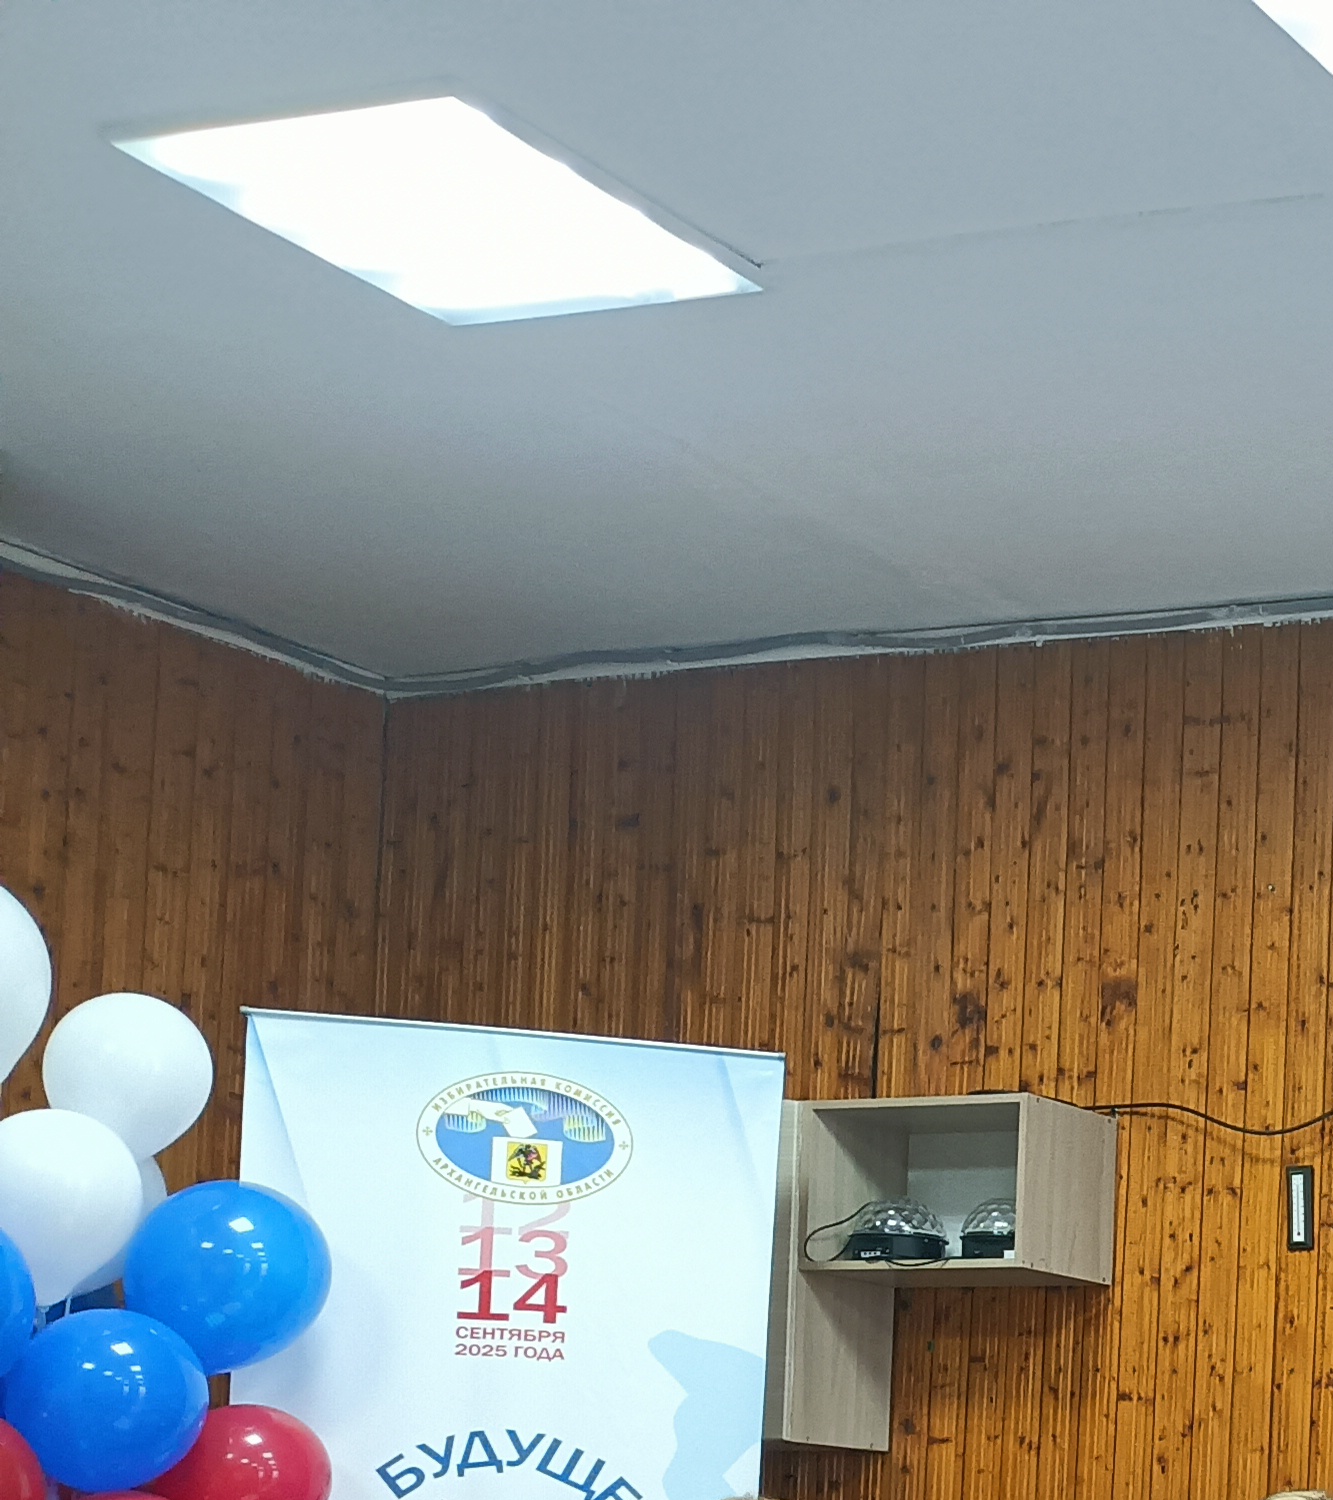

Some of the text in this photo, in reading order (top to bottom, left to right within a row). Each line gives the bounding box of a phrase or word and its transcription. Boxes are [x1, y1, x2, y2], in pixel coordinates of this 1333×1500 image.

[554, 1081, 622, 1127] КОМИССИЯ
[556, 1168, 615, 1199] ОБЛАСТИ
[458, 1226, 569, 1280] 13
[457, 1270, 568, 1324] 14
[454, 1344, 565, 1362] 2025 ГОДА
[455, 1326, 566, 1344] СЕНТЯБРЯ
